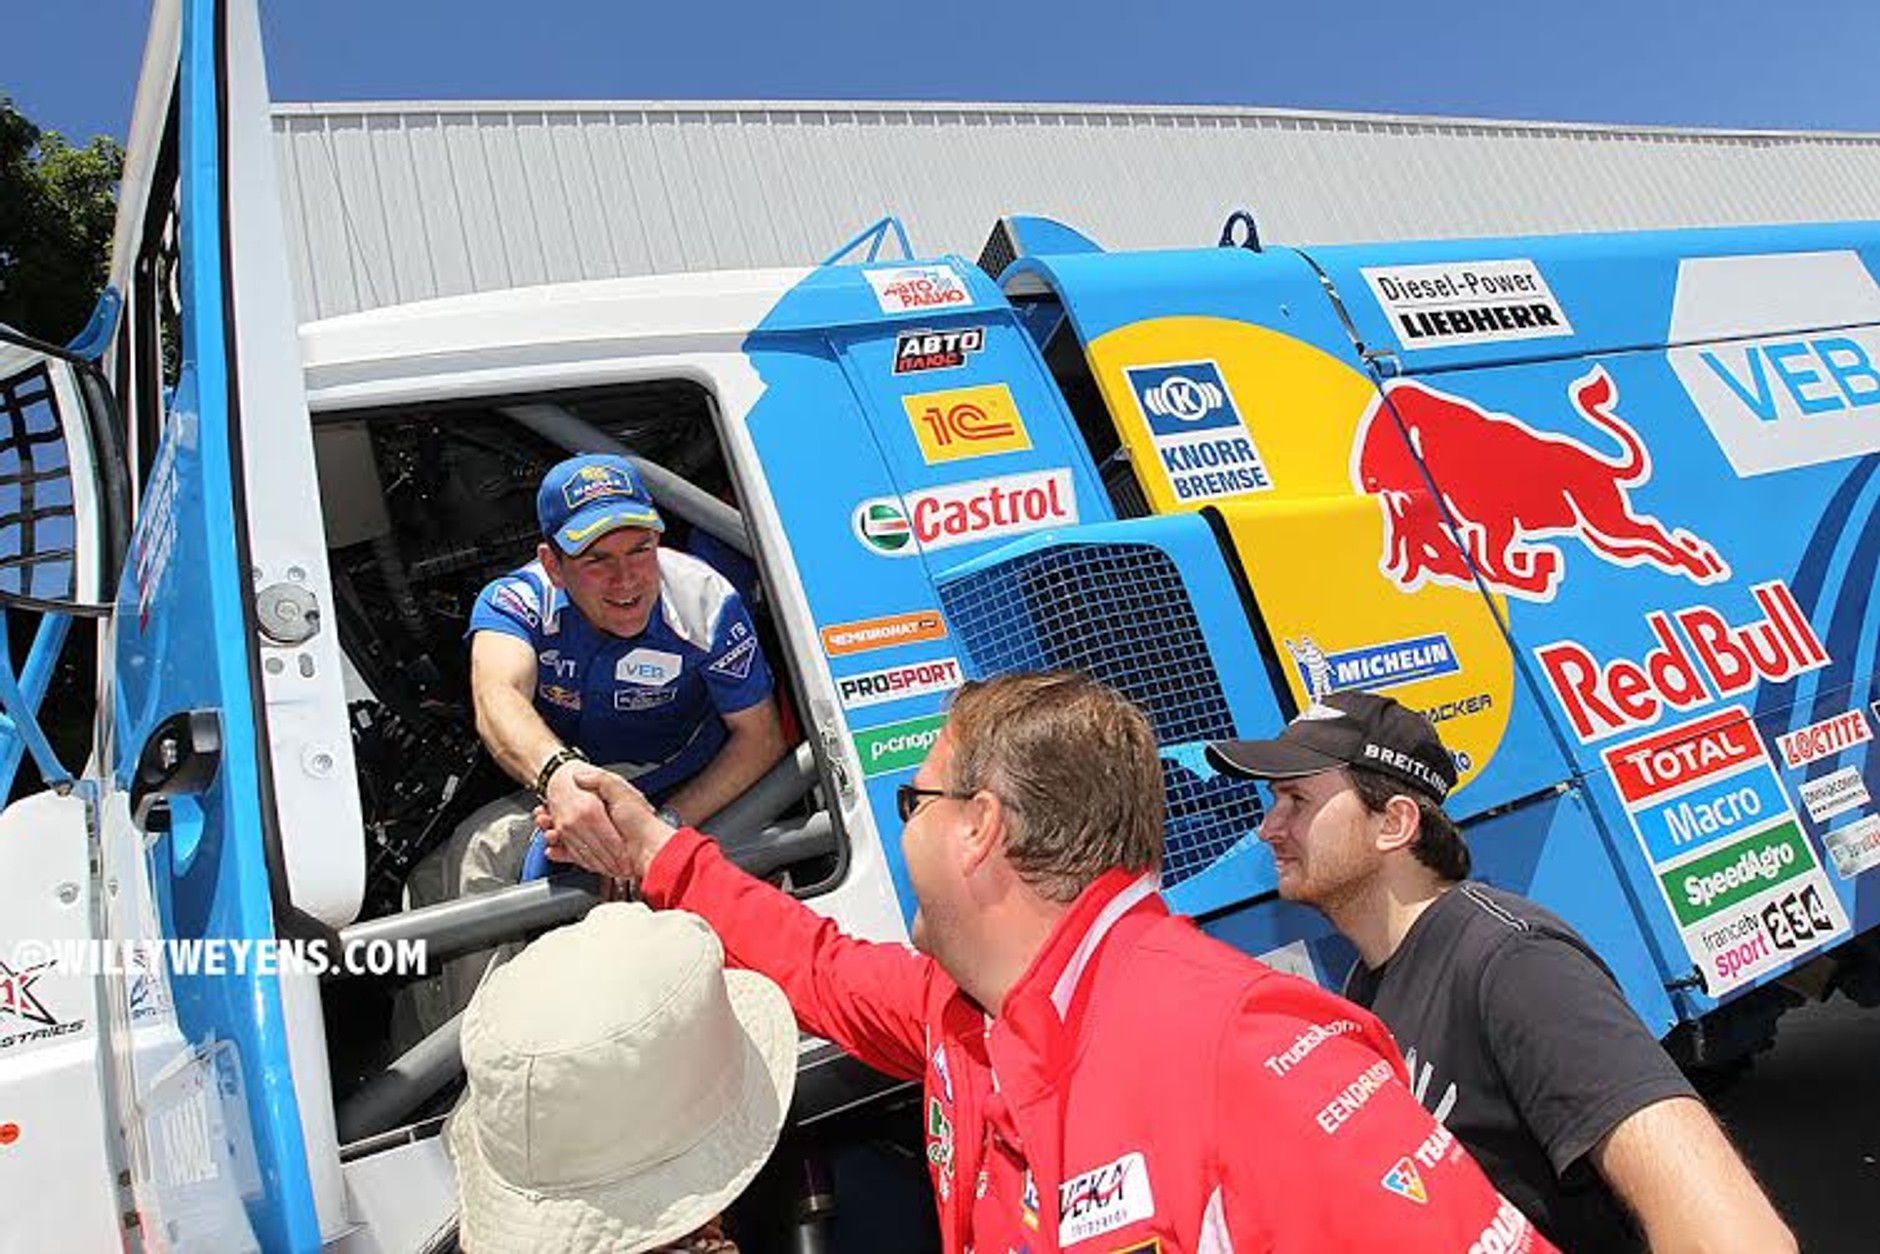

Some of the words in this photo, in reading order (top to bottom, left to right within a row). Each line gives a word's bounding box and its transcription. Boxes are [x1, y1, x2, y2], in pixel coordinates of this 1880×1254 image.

[1377, 273, 1538, 300] Diesel-Power
[1400, 304, 1560, 338] LIEBHERR
[1700, 337, 1880, 422] VEB
[1159, 438, 1256, 473] KNORR
[1174, 466, 1269, 499] BREMSE
[913, 478, 1067, 543] Castrol
[840, 662, 956, 700] PROSPORT
[1338, 642, 1450, 682] MICHELIN
[1539, 614, 1708, 740] Red
[1698, 582, 1826, 694] Bull
[1421, 694, 1492, 723] ACKER
[1626, 731, 1746, 786] TOTAL
[1784, 712, 1865, 766] LOCTITE
[1663, 787, 1762, 846] Macro
[1683, 842, 1795, 907] SpeedAgro
[1714, 932, 1770, 979] sport
